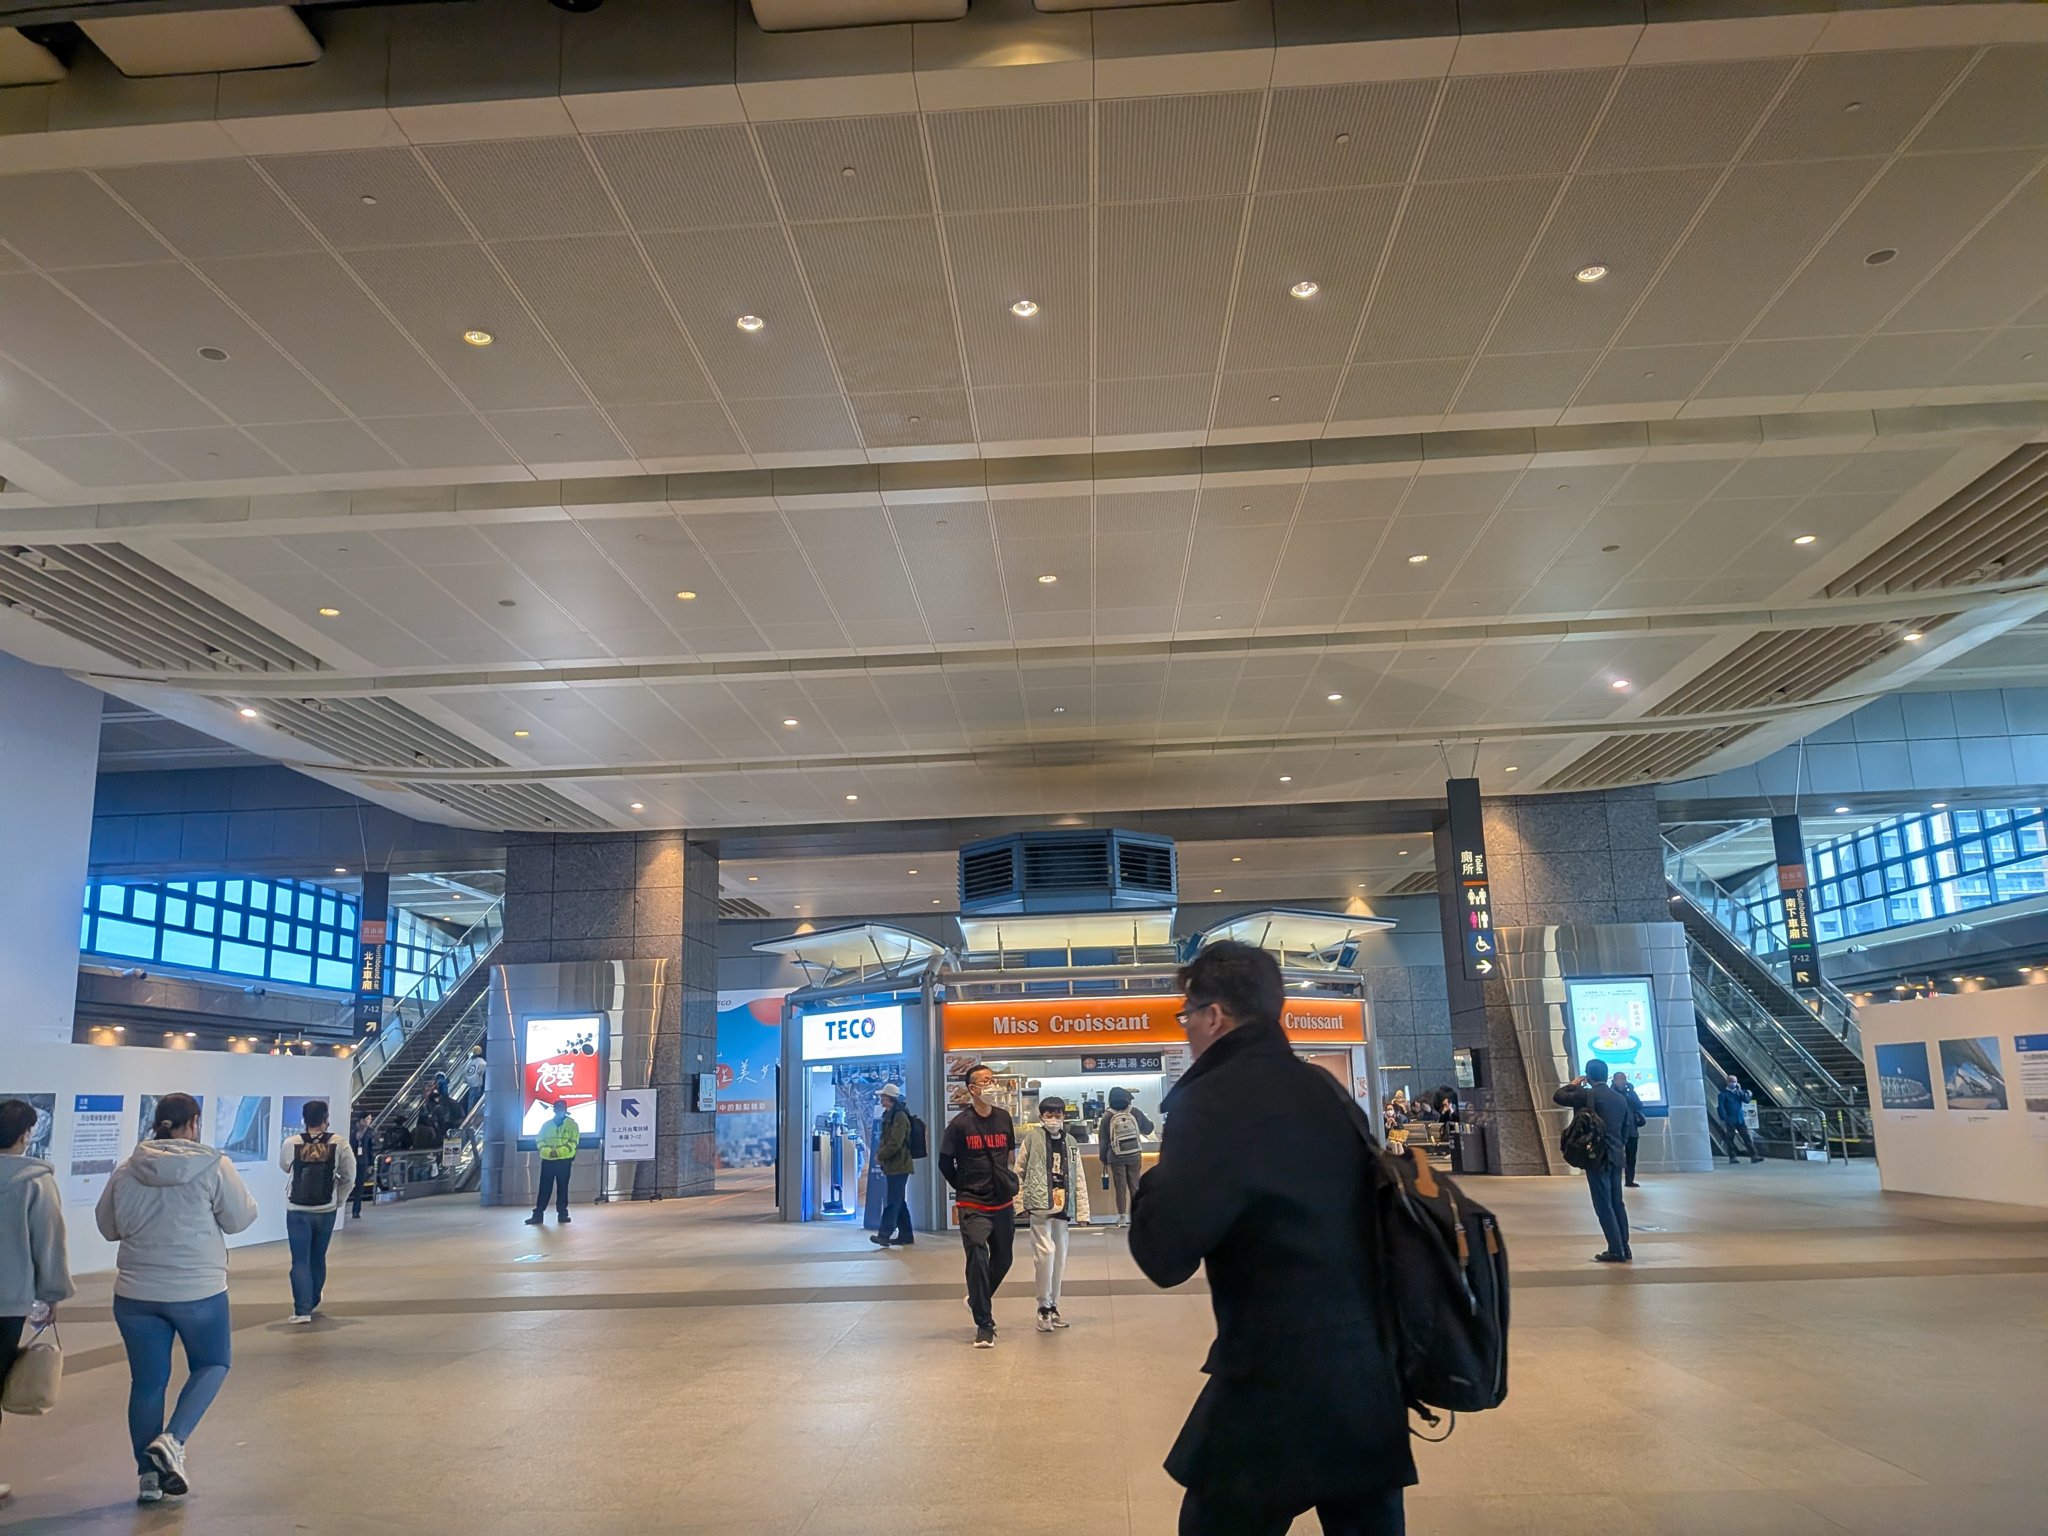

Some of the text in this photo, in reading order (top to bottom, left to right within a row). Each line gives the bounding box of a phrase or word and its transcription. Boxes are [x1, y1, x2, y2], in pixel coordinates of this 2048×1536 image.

[1460, 850, 1474, 876] 廁所
[1475, 854, 1484, 875] Toilet
[1784, 897, 1801, 939] 南下車廂
[1796, 888, 1809, 938] Southbound car
[374, 944, 382, 980] Northbound
[1792, 954, 1810, 963] 7-12
[361, 950, 374, 991] 北上車廂
[363, 1005, 380, 1013] 7-12
[825, 1017, 876, 1041] TECO
[993, 1013, 1150, 1034] Miss Croissant
[1284, 1012, 1344, 1030] Croissant
[1096, 1057, 1160, 1069] 玉米濃湯 $60
